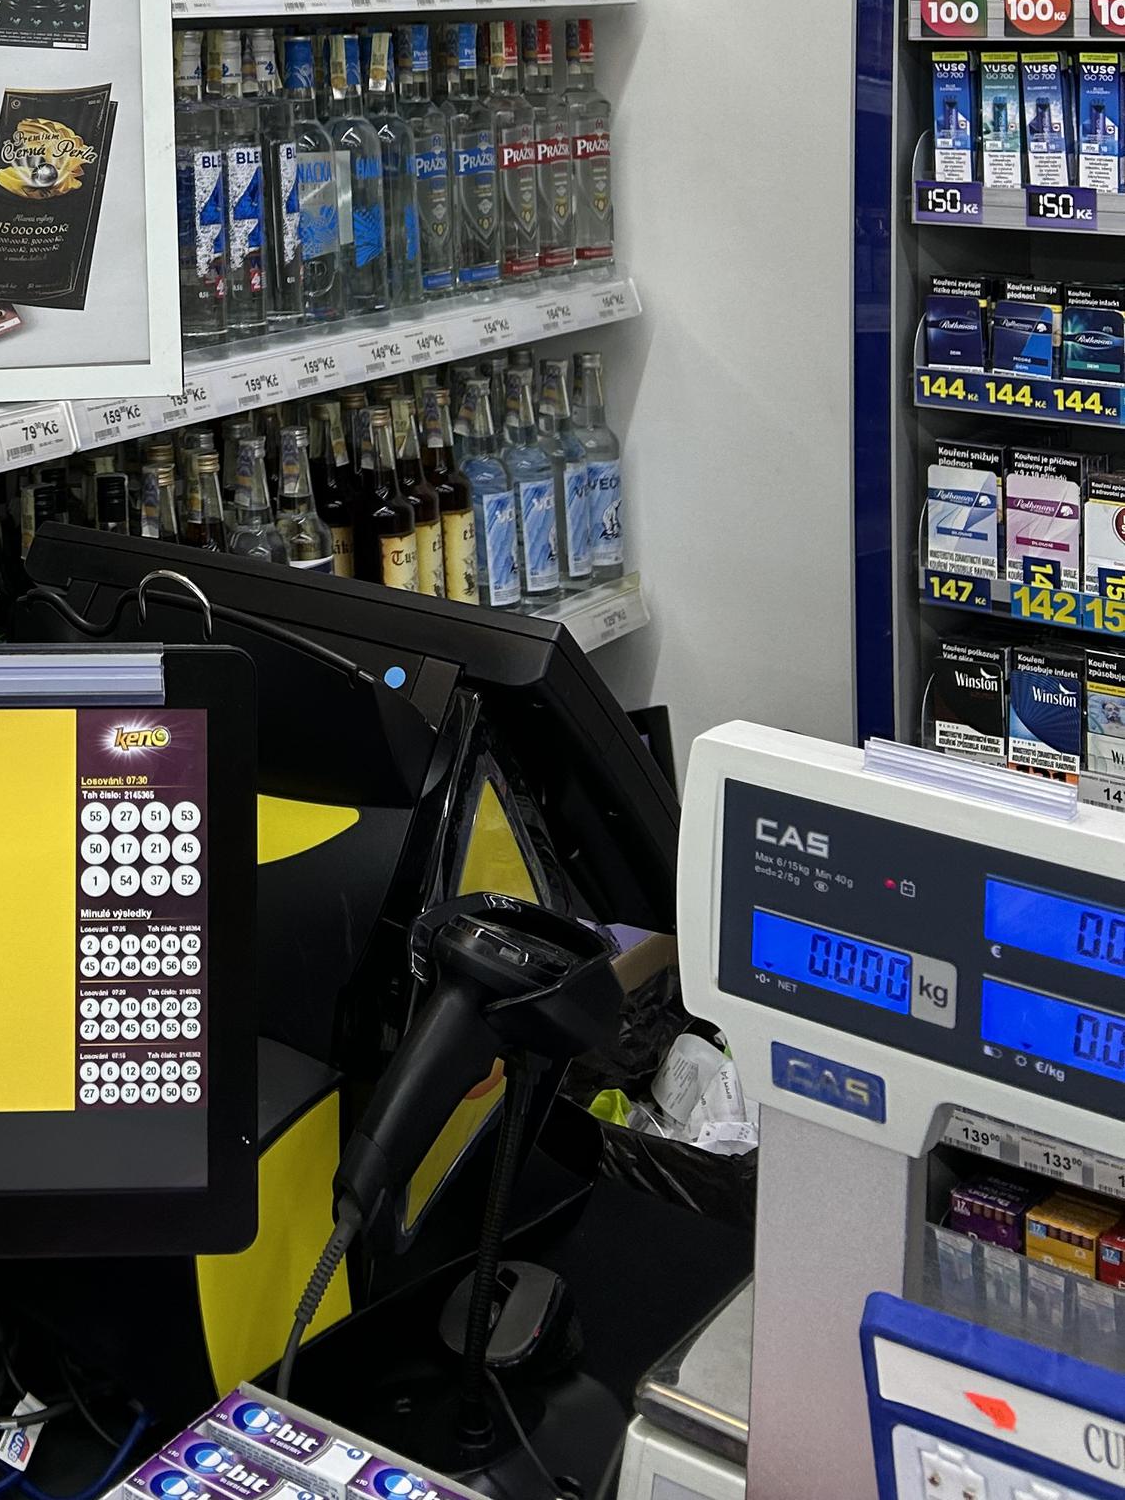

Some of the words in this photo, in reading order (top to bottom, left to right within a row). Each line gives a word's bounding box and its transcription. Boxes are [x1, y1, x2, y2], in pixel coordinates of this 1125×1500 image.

[928, 1, 979, 24] 100
[1054, 12, 1067, 21] Kč
[53, 141, 98, 164] Perla
[928, 189, 960, 213] 150
[963, 203, 979, 215] Kč
[920, 375, 966, 400] 144
[968, 392, 979, 402] Kč
[986, 382, 1033, 407] 144
[1035, 399, 1046, 409] Kč
[938, 446, 969, 459] Kouření
[930, 576, 974, 602] 147
[975, 596, 986, 606] Kč
[1013, 585, 1077, 624] 142
[955, 667, 998, 692] Winston
[114, 725, 171, 751] keno
[126, 776, 148, 785] 07:30
[90, 811, 102, 821] 55
[120, 811, 132, 821] 27
[151, 811, 162, 820] 51
[181, 811, 193, 820] 53
[90, 844, 102, 853] 50
[121, 844, 132, 853] 17
[151, 843, 162, 853] 21
[181, 843, 193, 852] 45
[755, 817, 829, 859] CAS
[755, 852, 774, 863] Max
[778, 980, 798, 994] NET
[918, 976, 949, 1007] kg
[233, 1401, 318, 1453] Orbit
